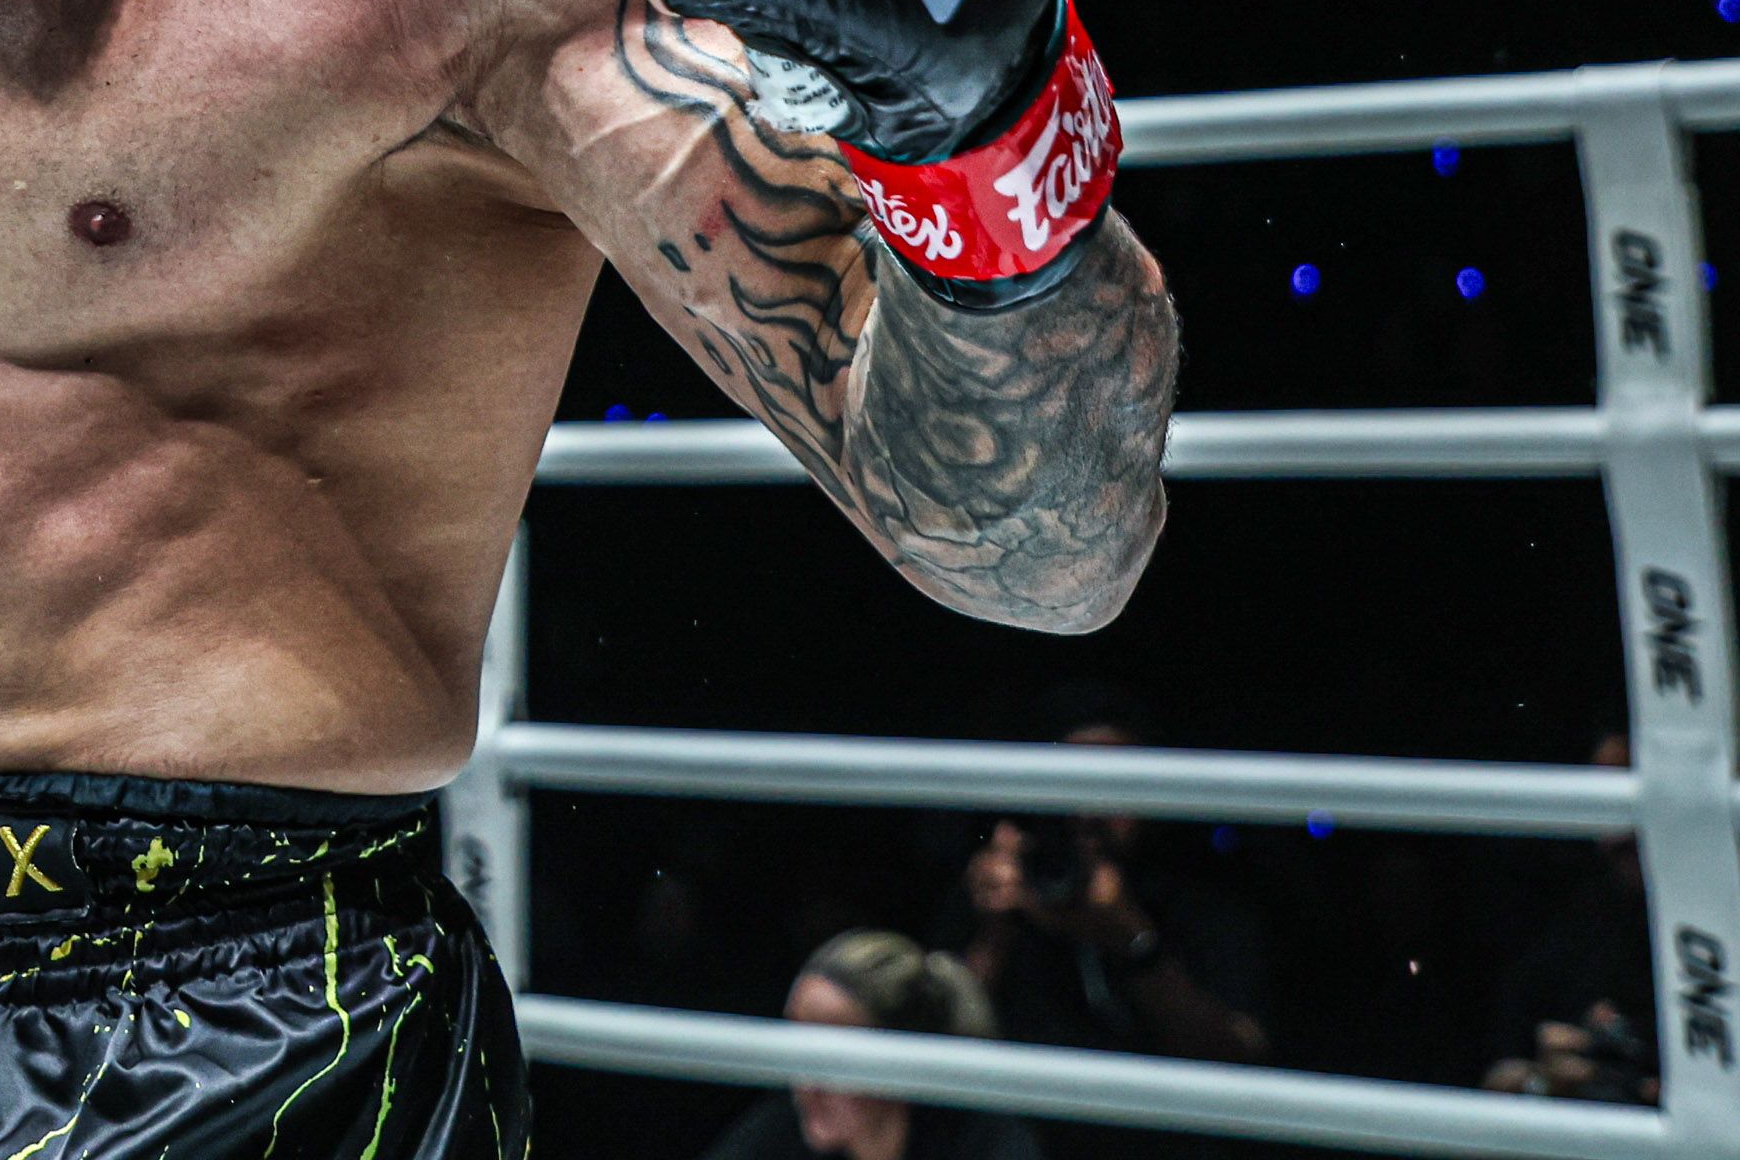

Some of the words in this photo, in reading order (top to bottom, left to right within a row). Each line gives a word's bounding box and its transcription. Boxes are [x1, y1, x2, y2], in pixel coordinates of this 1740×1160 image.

[1612, 228, 1673, 361] ONE
[1640, 564, 1702, 705] ONE
[1674, 923, 1737, 1070] ONE
